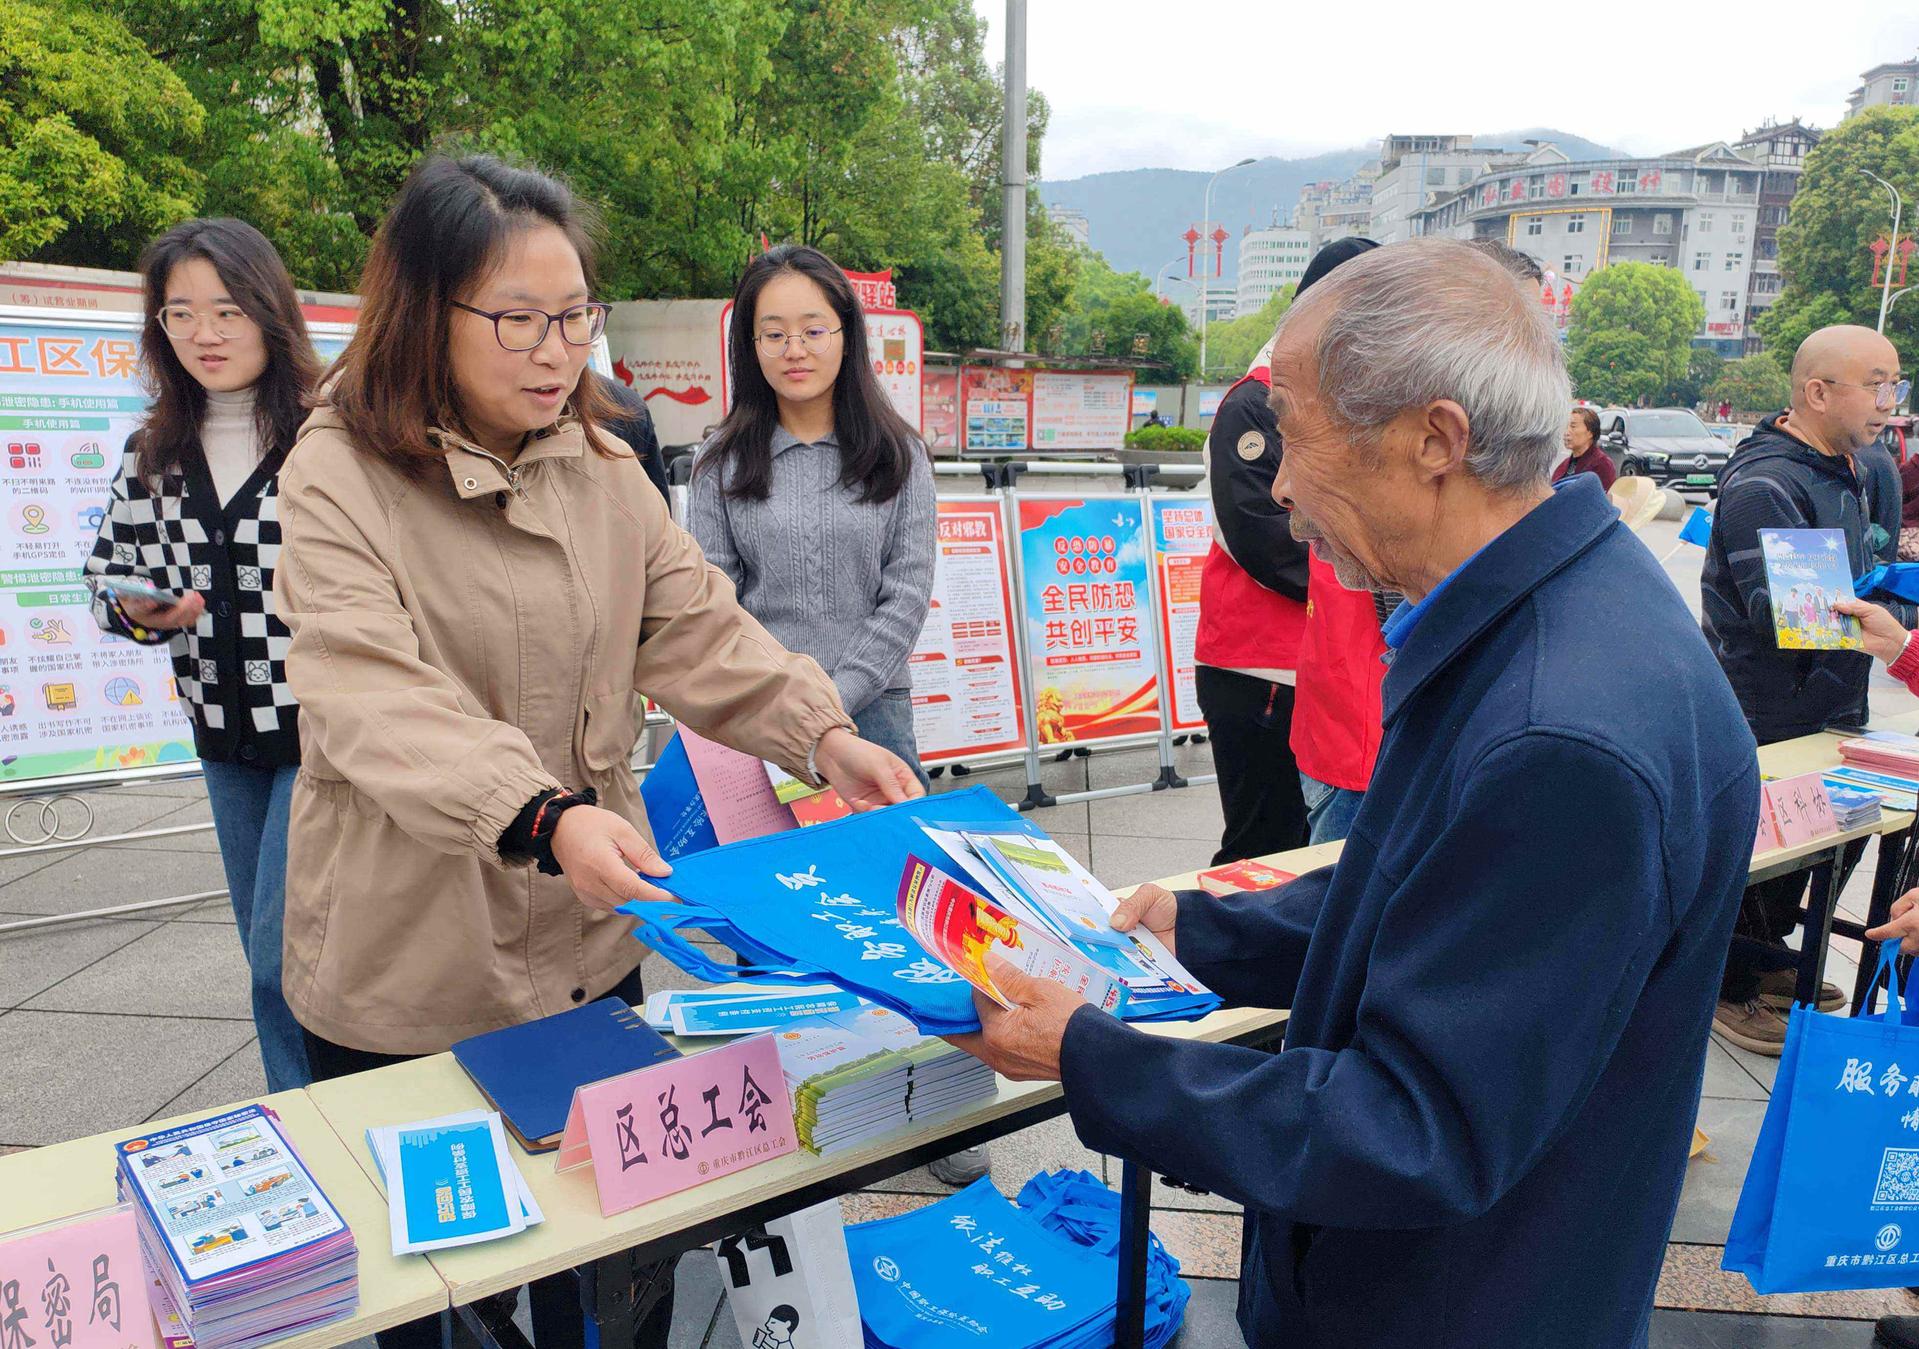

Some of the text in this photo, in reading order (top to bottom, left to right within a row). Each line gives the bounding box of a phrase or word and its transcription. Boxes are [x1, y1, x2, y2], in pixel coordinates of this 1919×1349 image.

[851, 280, 896, 309] 驿站
[22, 418, 81, 430] 手机使用篇
[939, 519, 987, 538] 反对邪教
[1058, 558, 1116, 574] 安全教育
[1042, 582, 1135, 613] 全民防恐
[1045, 616, 1138, 649] 共创平安
[616, 1064, 773, 1173] 区总工会
[712, 1136, 788, 1175] 重庆市黔江区总工会
[0, 1254, 121, 1348] 保密局
[971, 1262, 1066, 1312] 职工互助
